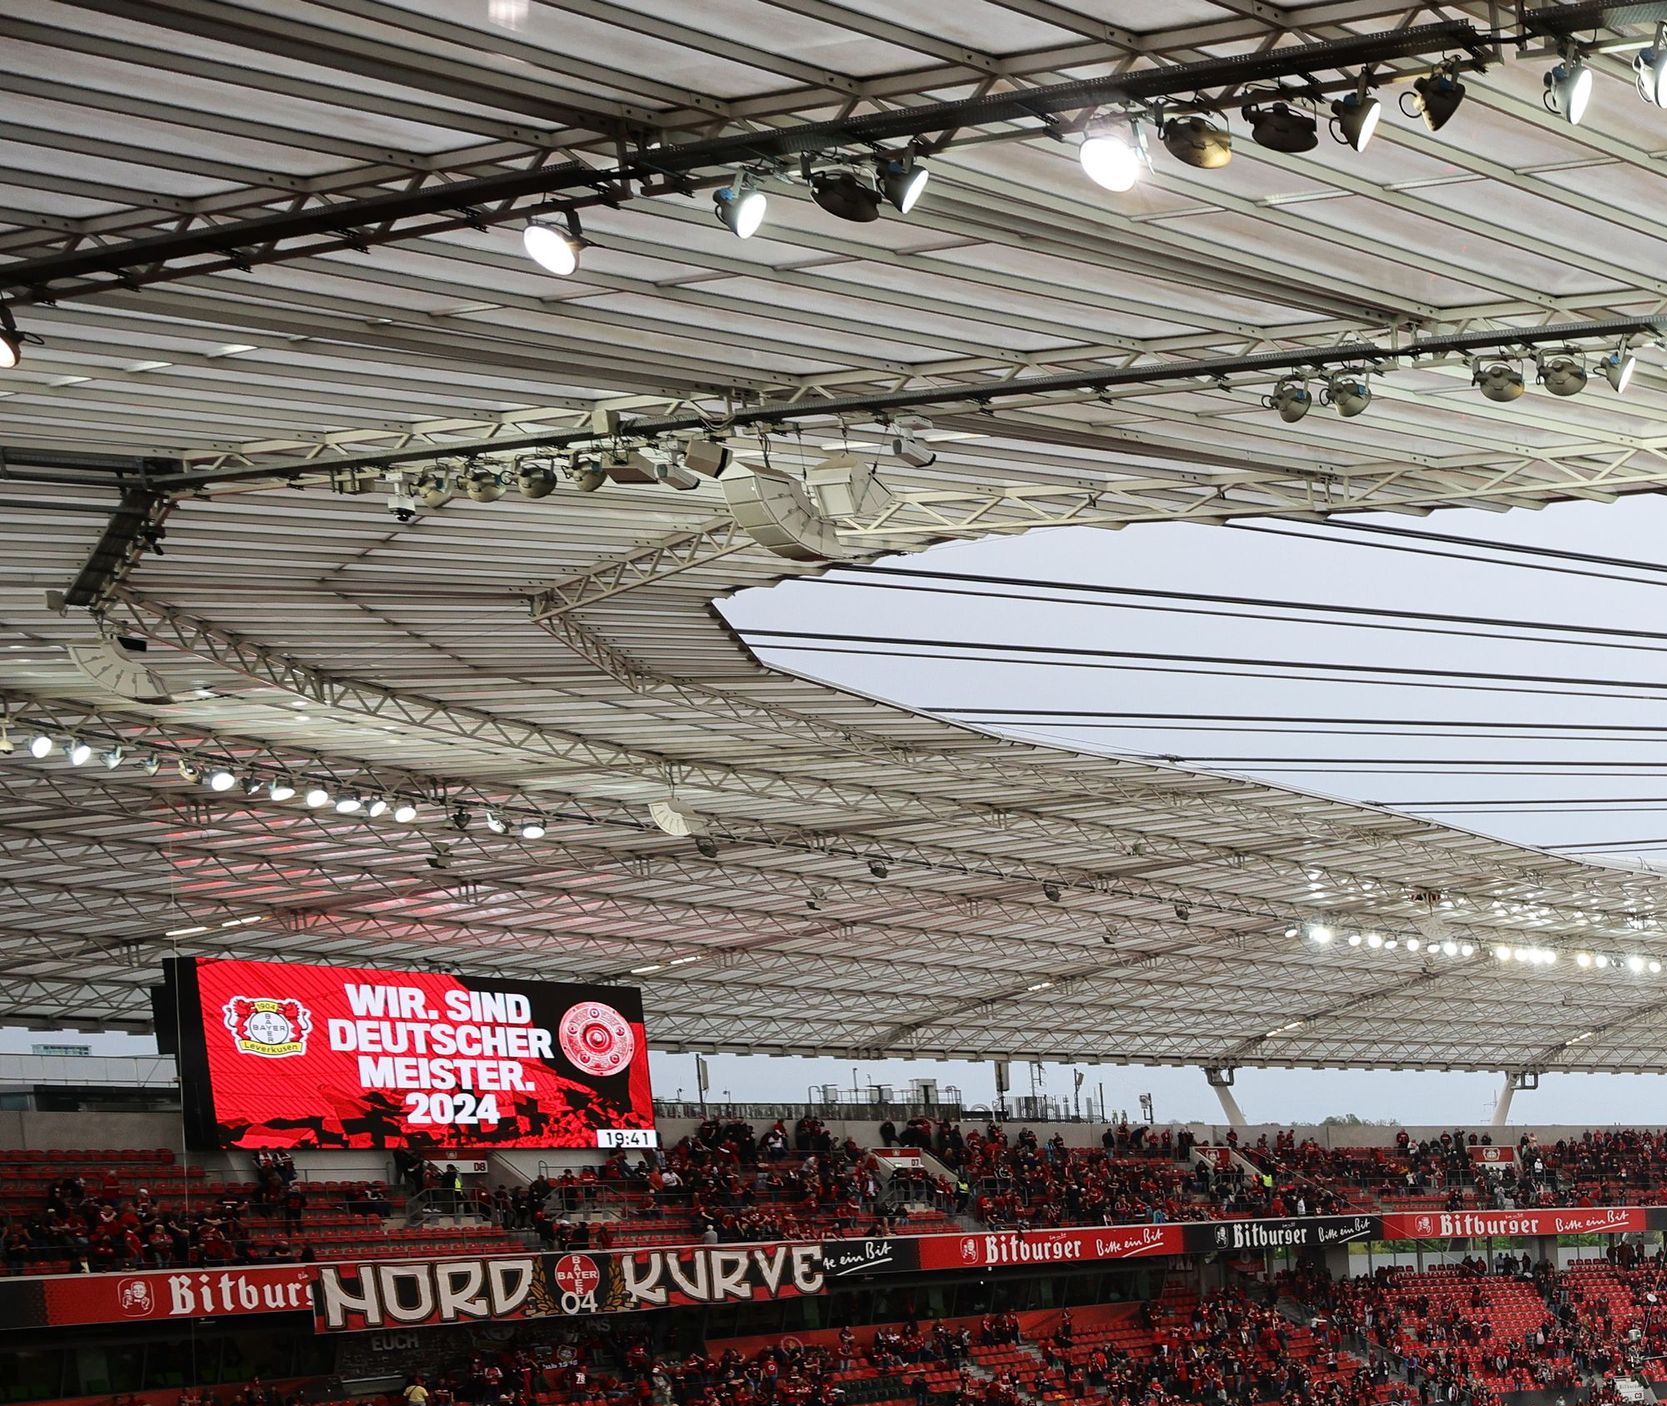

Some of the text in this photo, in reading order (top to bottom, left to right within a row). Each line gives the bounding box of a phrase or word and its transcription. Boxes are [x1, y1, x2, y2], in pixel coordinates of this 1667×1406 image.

[256, 1002, 277, 1011] 1904
[344, 983, 531, 1024] WIR. SIND
[242, 1041, 299, 1053] Leverkusen
[328, 1019, 554, 1059] DEUTSCHER
[357, 1056, 535, 1091] MEISTER.
[406, 1092, 500, 1125] 2024
[606, 1132, 649, 1146] 19:41
[474, 1162, 486, 1172] D8
[1318, 1218, 1370, 1242] Bitte ein Bit
[1440, 1213, 1538, 1236] Bitburger
[1555, 1209, 1627, 1232] Bitte ein Bit
[1097, 1228, 1163, 1256] Bitte ein Bit
[1233, 1224, 1307, 1247] Bitburger
[841, 1251, 864, 1266] ein
[866, 1242, 891, 1260] Bit
[985, 1235, 1081, 1264] Bitburger
[557, 1270, 597, 1280] BAYER
[621, 1245, 823, 1303] KURVE
[168, 1272, 314, 1315] Bitbur
[319, 1257, 533, 1328] NORD
[561, 1291, 597, 1313] 04
[372, 1336, 419, 1352] EUCH
